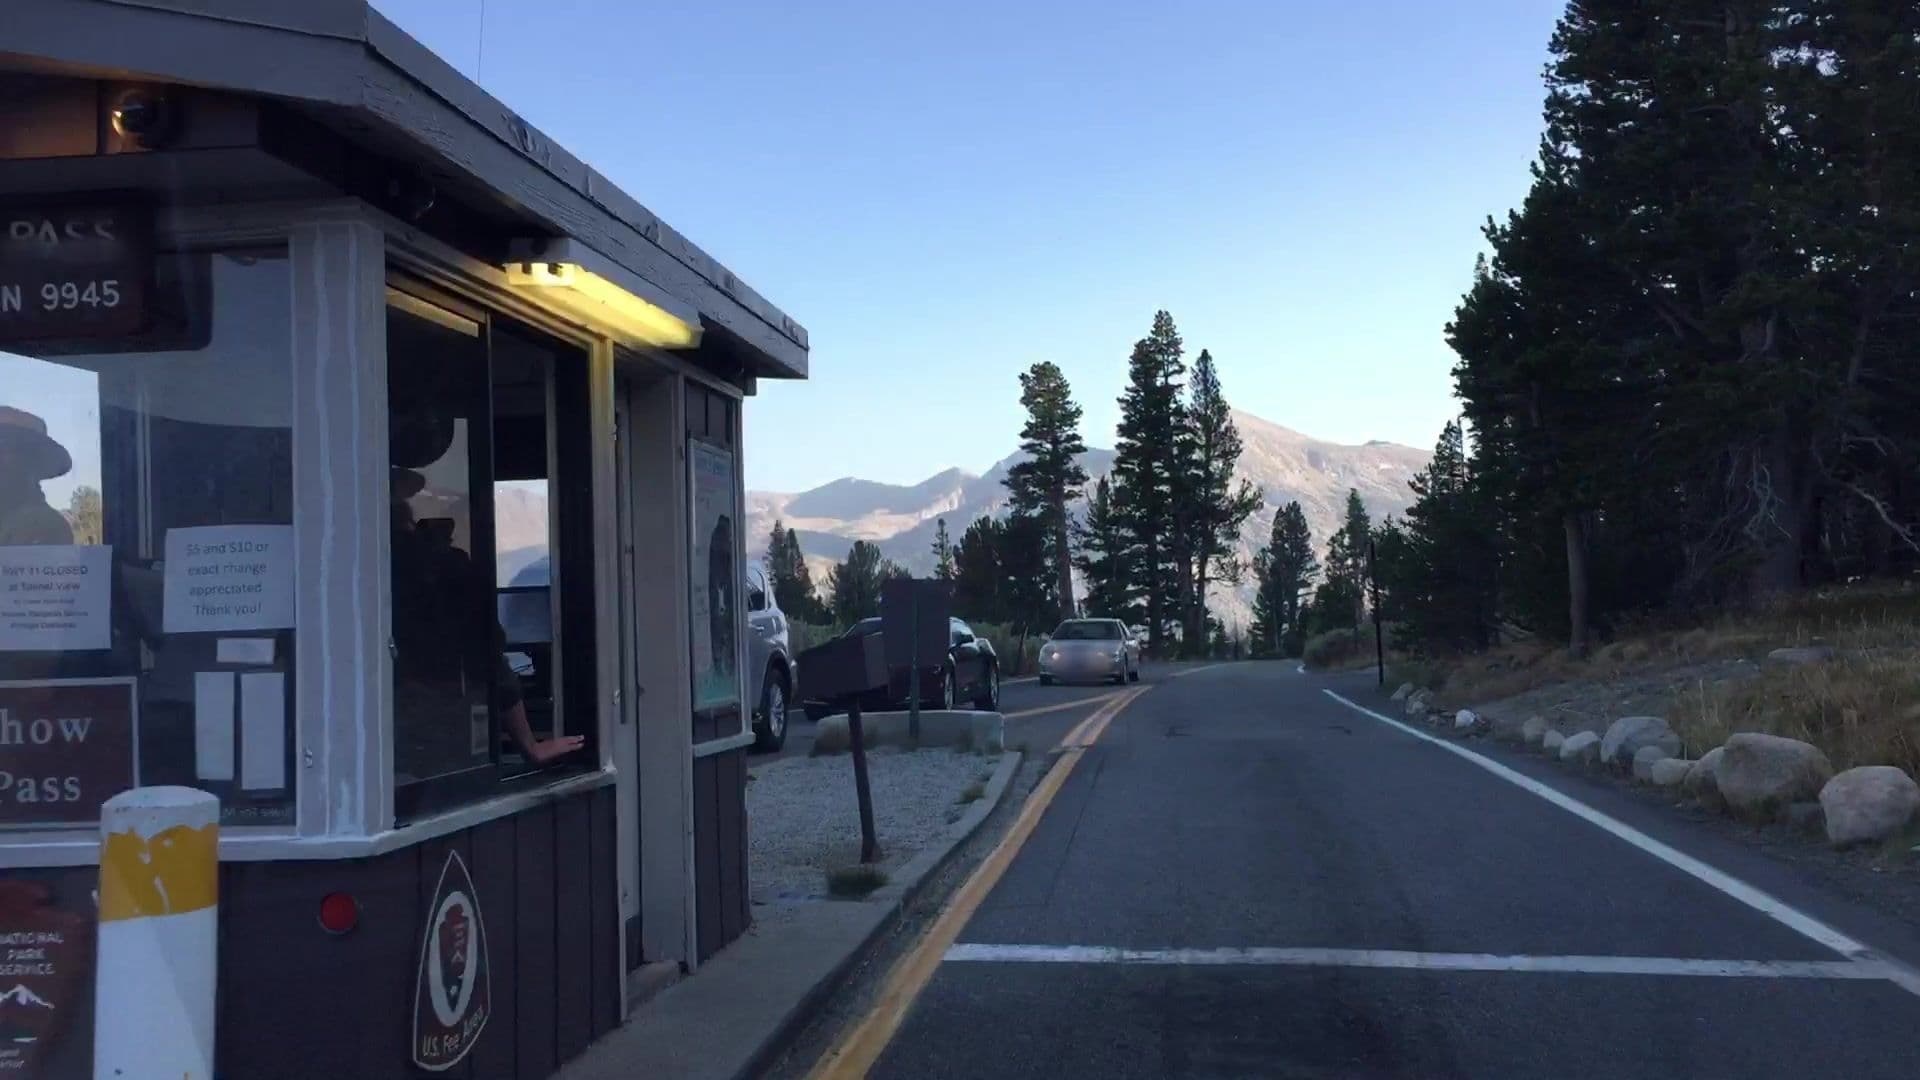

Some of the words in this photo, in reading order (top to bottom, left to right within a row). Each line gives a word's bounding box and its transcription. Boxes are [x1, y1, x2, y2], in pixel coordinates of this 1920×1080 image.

[41, 280, 120, 311] 9945
[203, 542, 226, 554] and
[255, 543, 270, 553] or
[43, 565, 88, 576] CLOSED
[187, 563, 219, 576] exact
[189, 582, 262, 597] appreciated
[192, 603, 231, 617] Thank
[234, 602, 262, 617] you!
[0, 708, 93, 745] how
[7, 948, 45, 961] PARK
